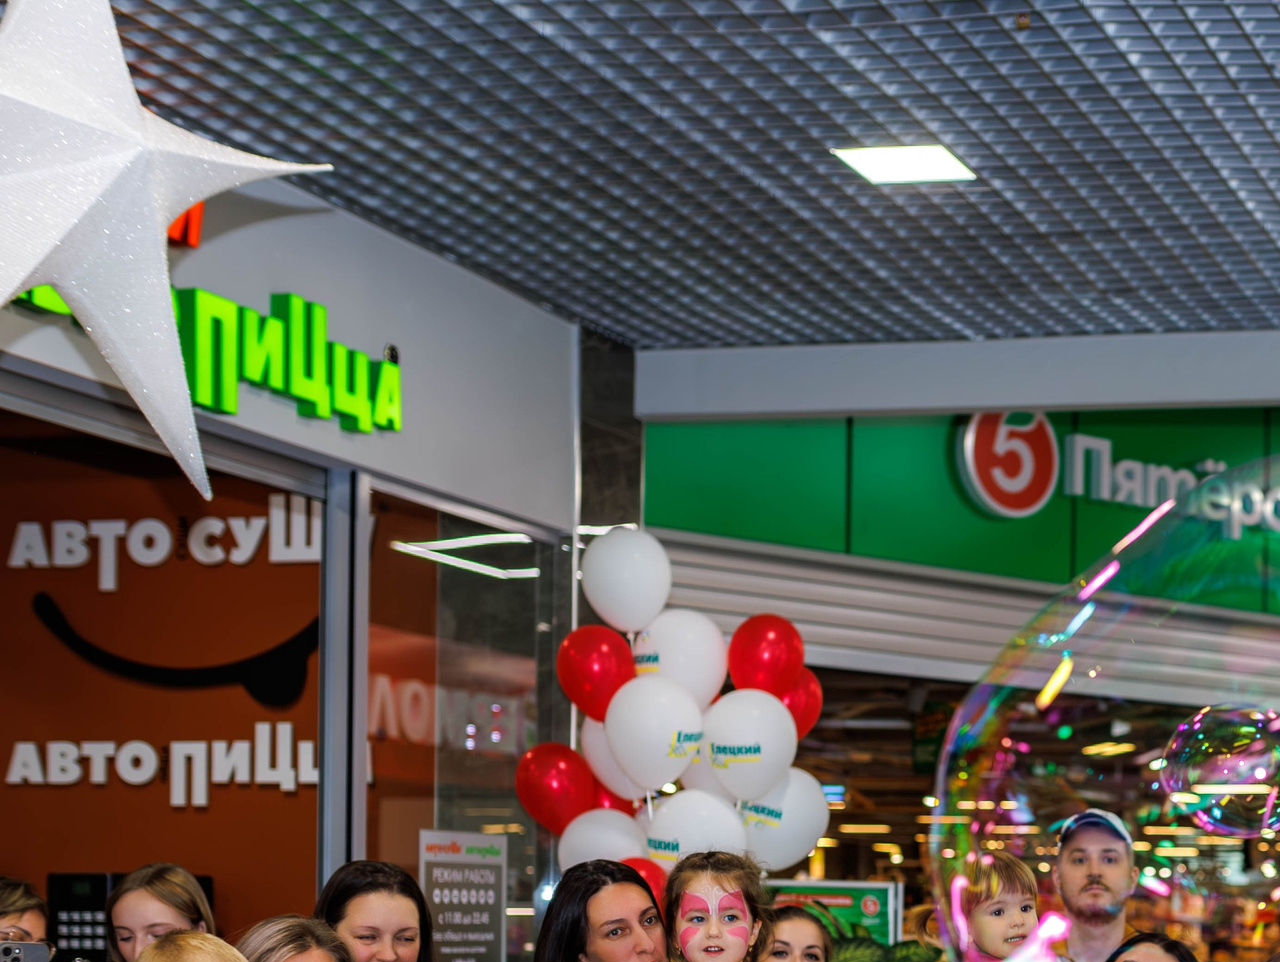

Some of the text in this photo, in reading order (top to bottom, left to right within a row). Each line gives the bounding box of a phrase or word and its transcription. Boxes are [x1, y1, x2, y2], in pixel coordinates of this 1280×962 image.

[8, 518, 174, 592] АВТО
[187, 493, 321, 566] СУШ
[5, 740, 159, 786] АВТО
[169, 721, 320, 807] ПИЦ
